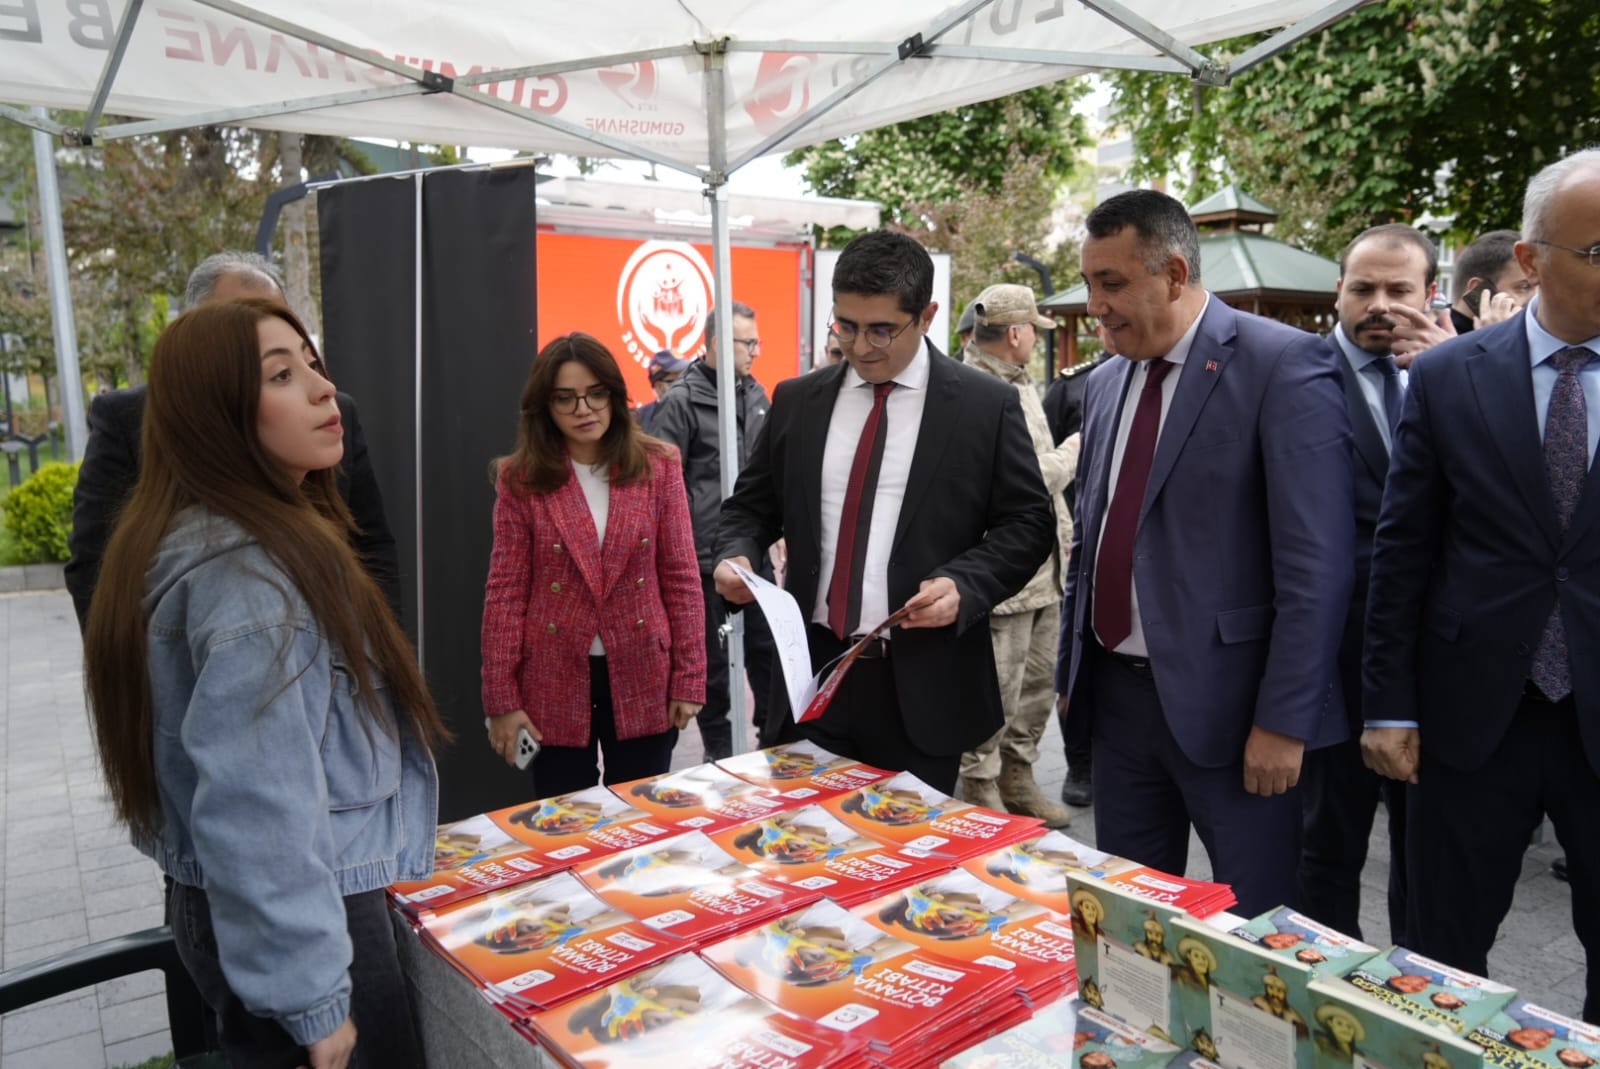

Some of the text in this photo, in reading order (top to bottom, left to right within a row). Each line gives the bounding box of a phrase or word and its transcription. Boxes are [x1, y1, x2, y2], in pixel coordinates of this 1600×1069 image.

[929, 820, 996, 839] BOYAMA
[825, 860, 890, 881] BOYAMA
[552, 943, 618, 973] BOYAMA
[991, 932, 1075, 962] BOYAMA
[854, 974, 943, 1008] BOYAMA
